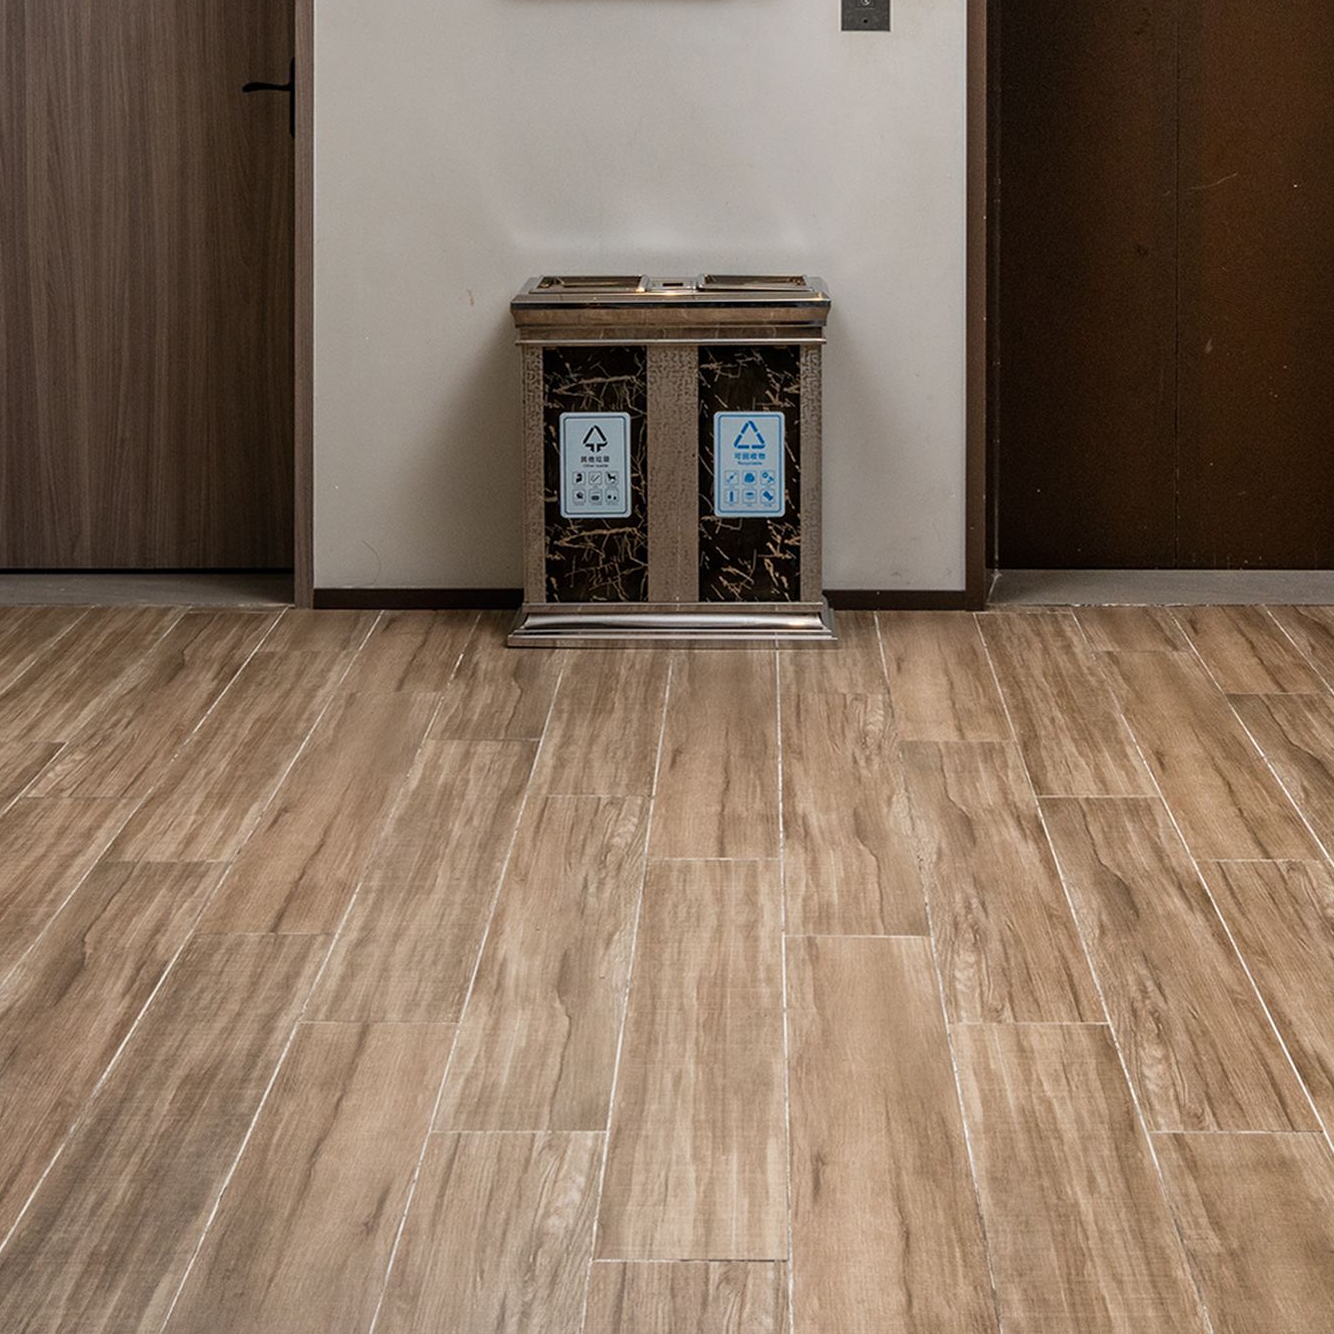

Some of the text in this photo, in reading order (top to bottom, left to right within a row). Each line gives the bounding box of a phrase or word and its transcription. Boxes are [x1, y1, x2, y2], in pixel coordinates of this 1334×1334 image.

[580, 455, 610, 464] 其他垃圾
[734, 452, 766, 461] 可回收物
